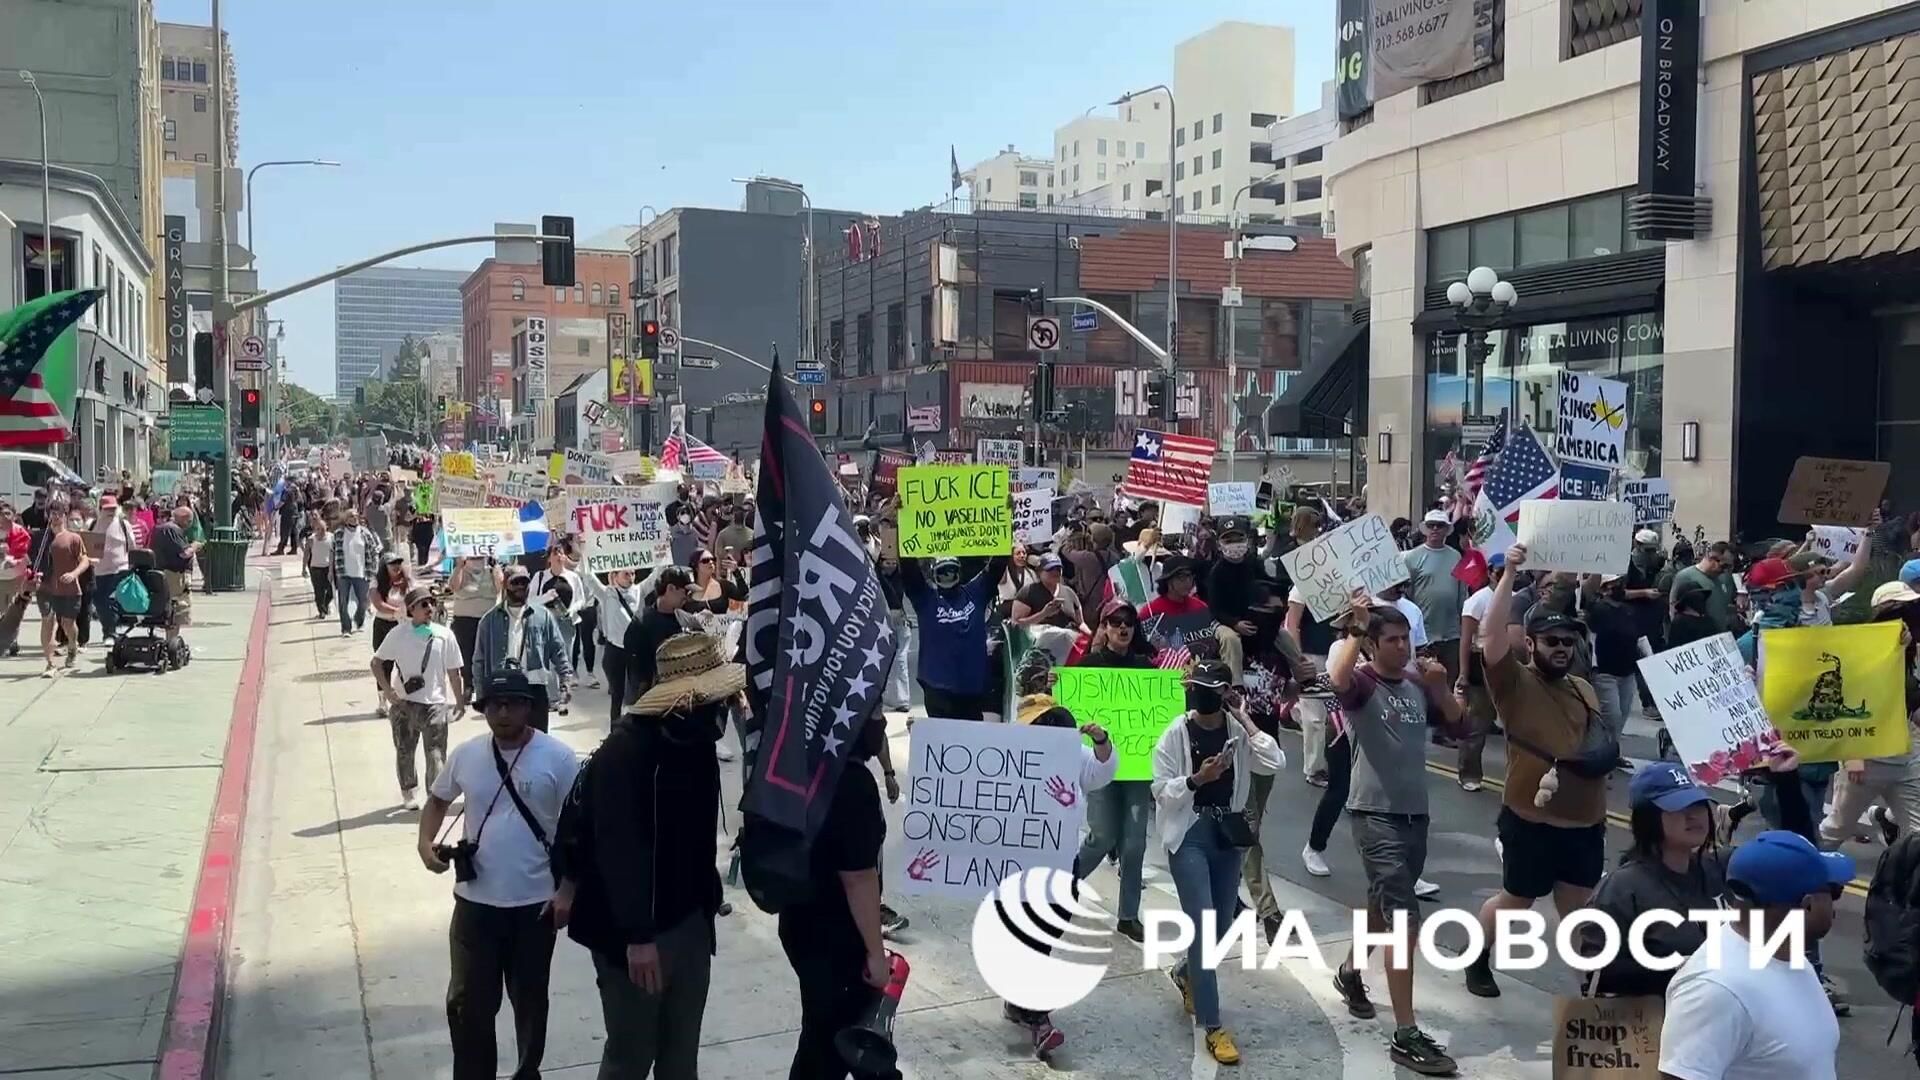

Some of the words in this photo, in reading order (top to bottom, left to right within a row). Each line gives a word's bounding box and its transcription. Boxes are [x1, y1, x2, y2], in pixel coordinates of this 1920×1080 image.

[1660, 18, 1674, 51] ON
[1657, 58, 1672, 172] BROADWAY
[168, 227, 185, 357] GRAYSON
[529, 319, 545, 371] ROSS
[1569, 327, 1618, 348] LIVING
[1561, 372, 1579, 394] NO
[1560, 395, 1597, 422] KINGS
[1561, 418, 1573, 437] IN
[879, 453, 913, 468] TRUMP
[1558, 436, 1619, 463] AMERICA
[507, 470, 532, 486] ICE
[874, 473, 896, 485] MUST
[906, 476, 959, 505] FUCK
[969, 470, 1004, 499] ICE
[1561, 478, 1583, 496] ICE
[575, 504, 629, 533] FUCK
[631, 501, 661, 512] TRUMP
[915, 510, 936, 529] NO
[944, 505, 1006, 526] VASELINE
[607, 533, 626, 542] THE
[629, 529, 661, 542] RACIST
[641, 520, 658, 531] ICE
[448, 533, 500, 546] MELTS
[473, 544, 496, 556] ICE
[1816, 538, 1831, 549] NO
[1294, 533, 1339, 581] GOT
[1315, 568, 1342, 589] WE
[1351, 543, 1381, 569] GOT
[1665, 647, 1704, 676] WERE
[1058, 671, 1182, 704] DISMANTLE
[1664, 690, 1688, 711] WE
[1688, 676, 1719, 701] NEED
[1719, 673, 1731, 689] TO
[1074, 705, 1169, 729] SYSTEMS
[1728, 701, 1747, 721] AND
[1814, 728, 1844, 740] TREAD
[1847, 728, 1862, 738] ON
[1864, 726, 1876, 737] ME
[925, 744, 972, 775] NO
[976, 746, 1045, 781] ONE
[1669, 768, 1690, 785] LA
[1566, 1018, 1628, 1046] Shop
[1566, 1044, 1641, 1069] fresh.
